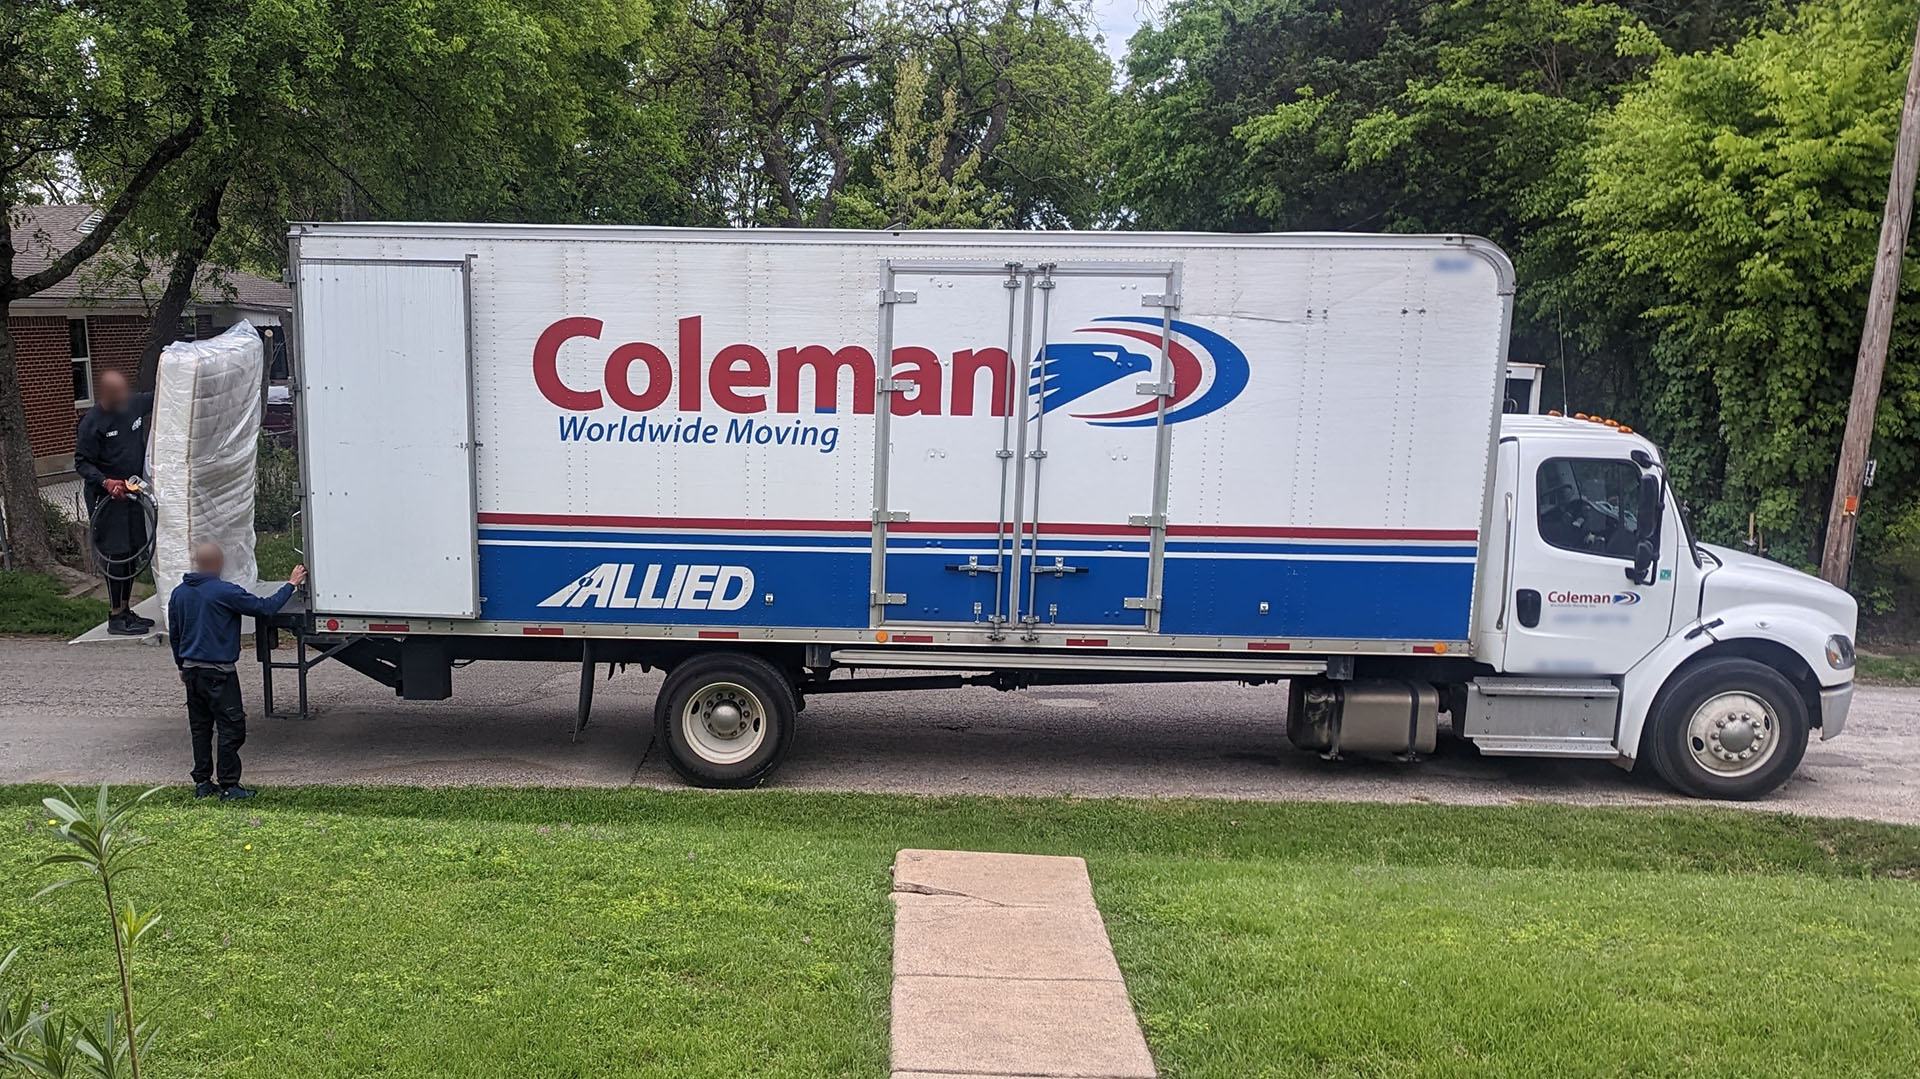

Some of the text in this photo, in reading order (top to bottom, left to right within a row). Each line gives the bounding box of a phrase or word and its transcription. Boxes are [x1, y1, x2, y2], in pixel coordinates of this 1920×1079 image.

[533, 315, 1015, 417] Coleman
[559, 416, 839, 453] Worldwide Moving
[536, 563, 755, 611] ALLIED
[1548, 591, 1611, 604] Coleman
